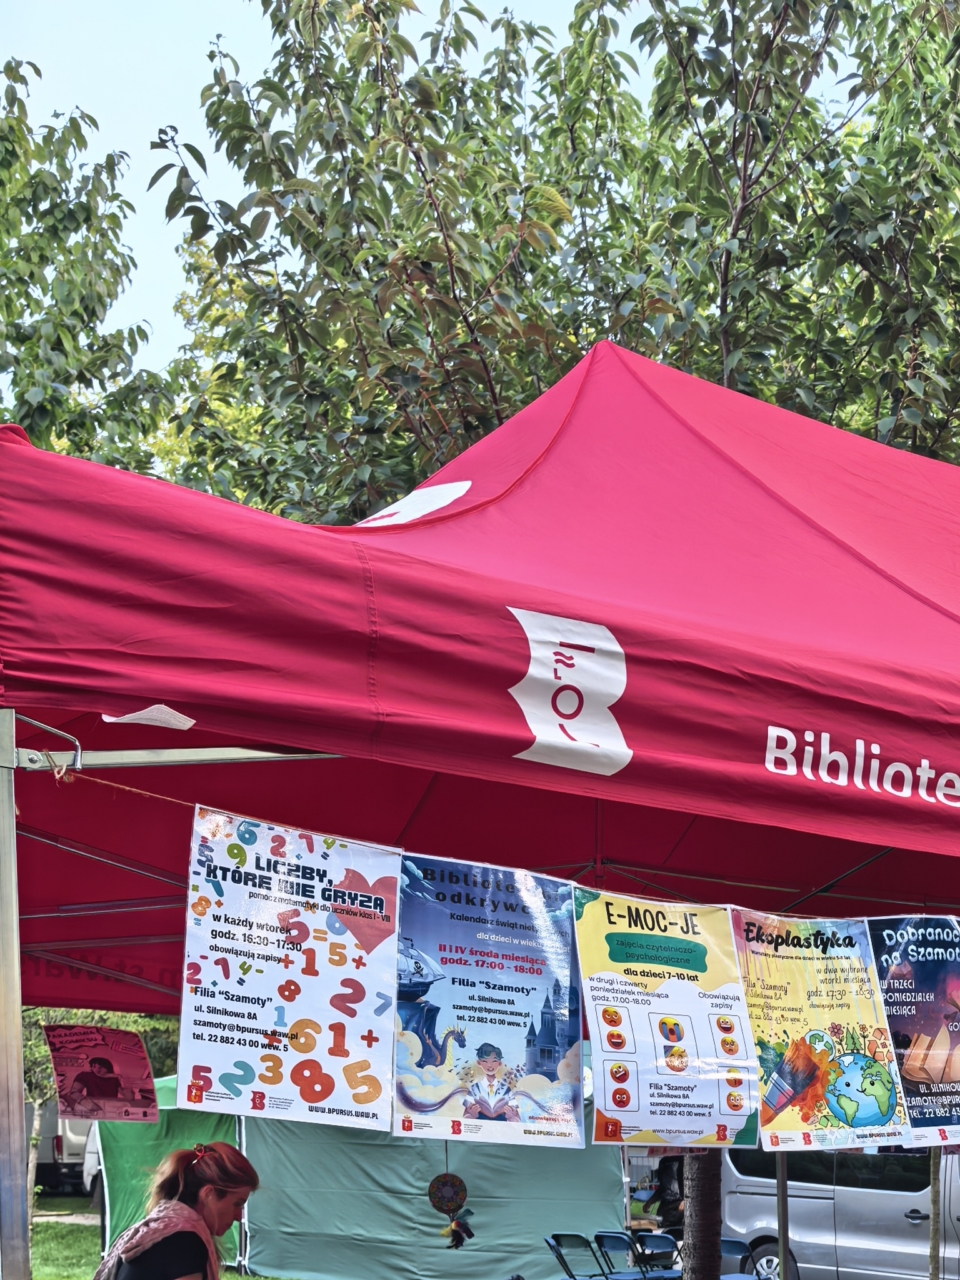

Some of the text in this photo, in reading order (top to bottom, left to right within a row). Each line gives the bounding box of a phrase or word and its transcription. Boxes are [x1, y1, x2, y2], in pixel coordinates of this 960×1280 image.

[255, 853, 334, 887] LICZBY,
[206, 863, 384, 914] KTÓRE NIE GRYZĄ
[249, 891, 373, 920] pomoc matematyki dla uczniów klas
[212, 913, 292, 935] w każdy wtorek
[450, 912, 518, 930] Kalendarz świąt
[605, 901, 700, 935] E-MOC-JE
[211, 928, 239, 942] godz.
[477, 932, 512, 943] dla dzieci
[744, 922, 857, 954] Ekoplastyka
[209, 943, 282, 964] obowiązują zapisy
[616, 939, 696, 955] zajęcia czytelniczo-
[454, 945, 546, 966] IV środa miesiąca
[626, 951, 690, 965] psychologiczne
[881, 952, 901, 967] na
[440, 956, 542, 975] godz. 17:00 18:00
[824, 964, 868, 979] dwa wybrane
[452, 977, 476, 987] Filia
[624, 968, 699, 982] dla dzieci 7-10 lat
[820, 976, 841, 985] wtorki
[596, 976, 648, 989] drugi czwarty
[890, 980, 914, 988] TRZECI
[194, 986, 216, 999] Filia
[590, 985, 669, 999] poniedziałek miesiąca
[592, 995, 611, 1003] godz.
[698, 991, 740, 1002] Obowiązują
[826, 986, 875, 1000] 17:30 18:30
[478, 995, 506, 1004] Silnikowa
[710, 1002, 733, 1010] zapisy
[194, 1005, 258, 1021] ul. Silnikowa 8A
[452, 1003, 530, 1018] szamoty@bpursus.waw.pl
[193, 1019, 298, 1041] szamoty@bpursus.waw.pl
[193, 1032, 289, 1052] tel. 22 882 43 00 wew. 5
[919, 1084, 930, 1093] UL.
[650, 1101, 714, 1109] szamoty@bpursus.waw.pl
